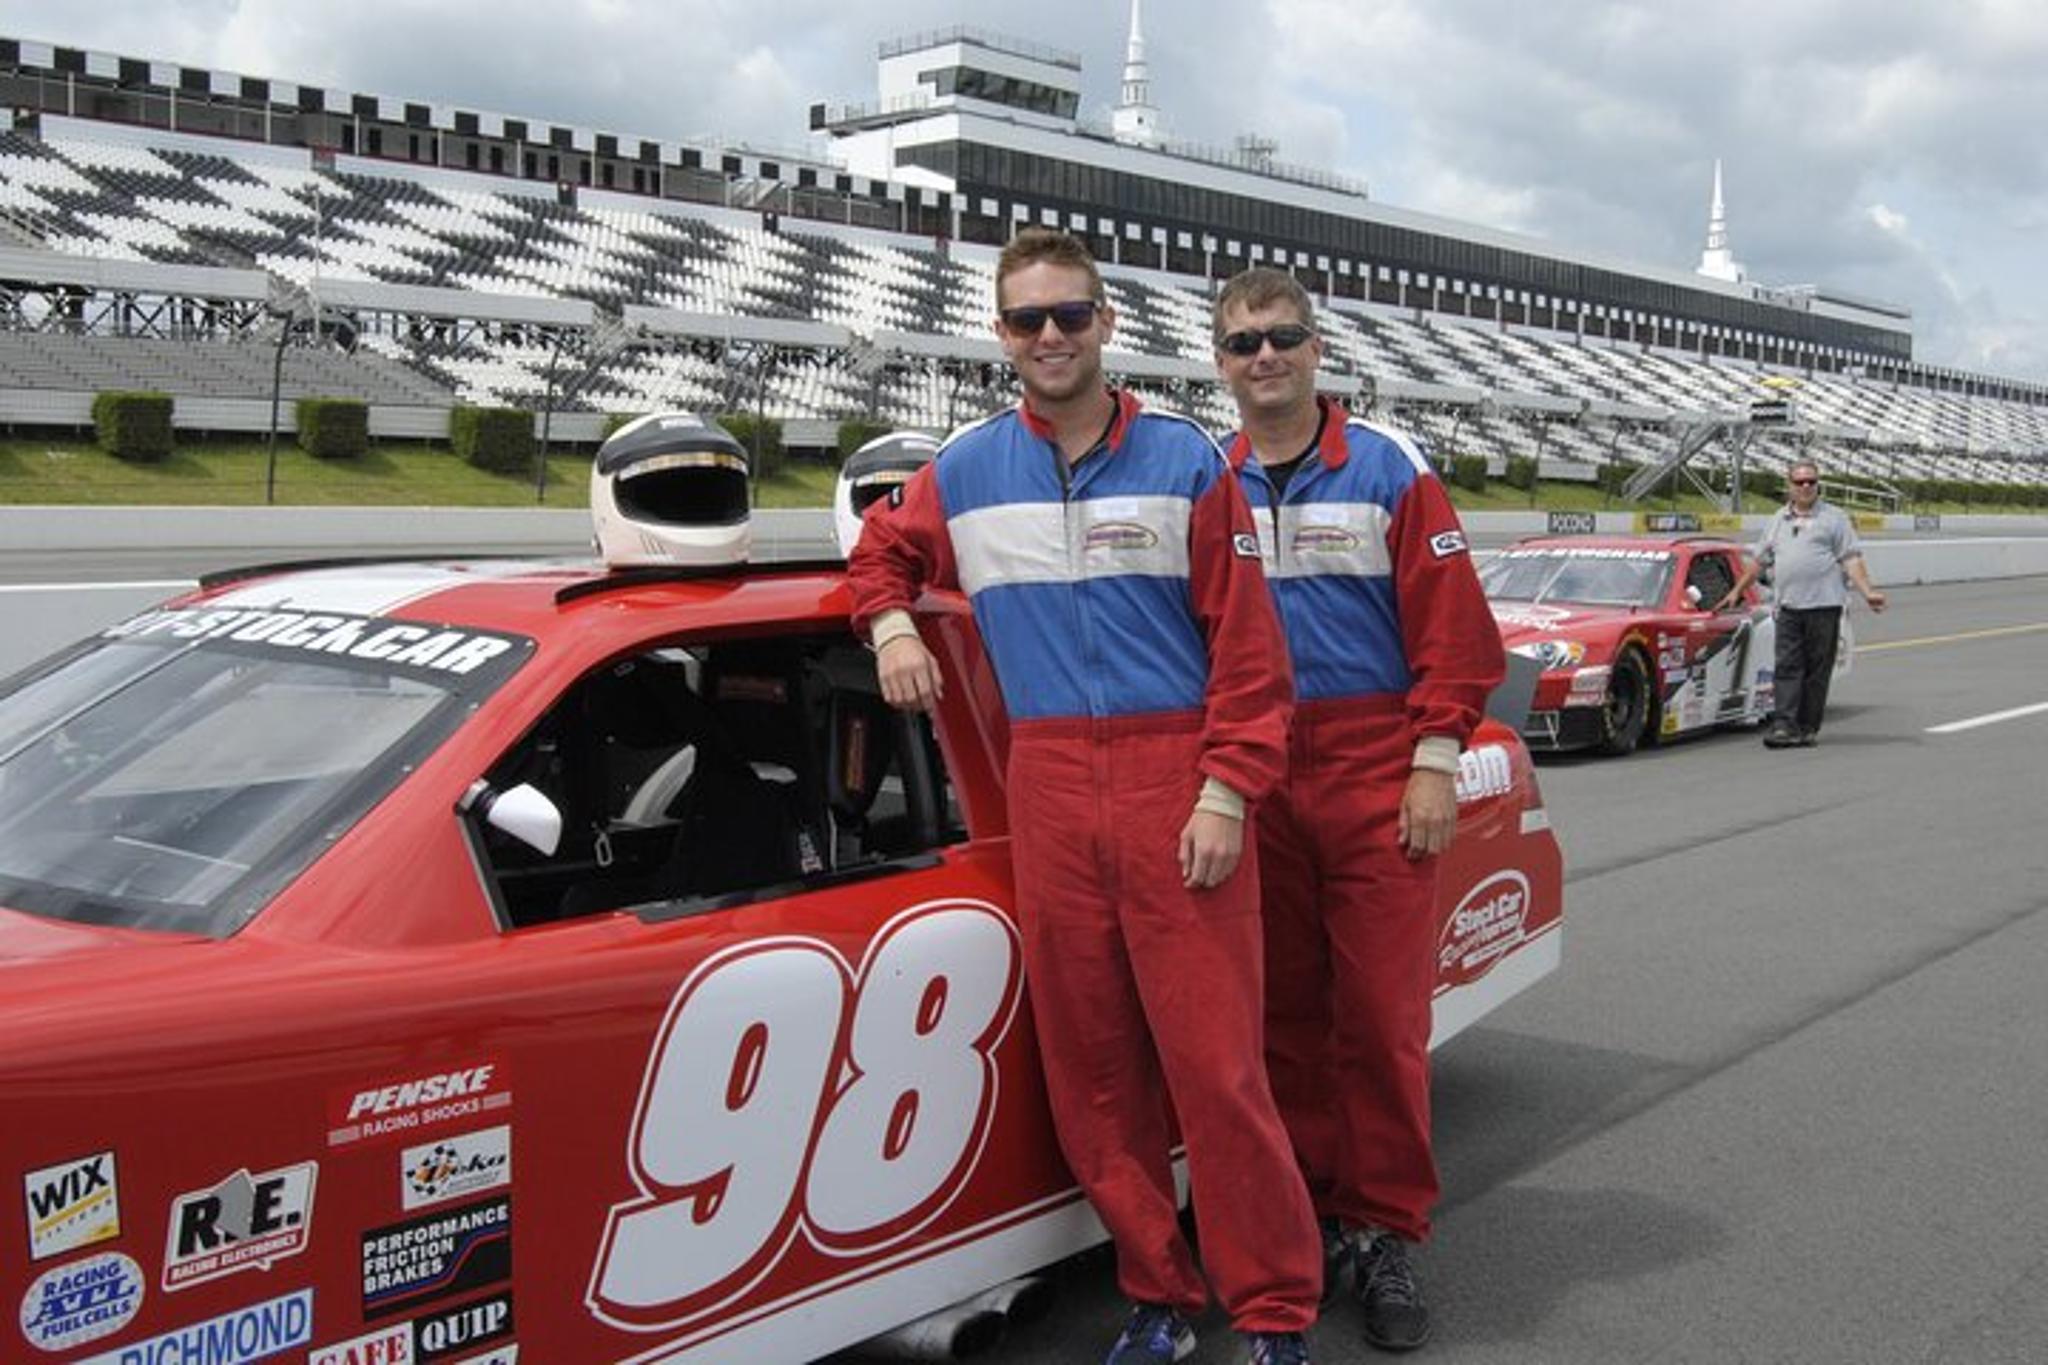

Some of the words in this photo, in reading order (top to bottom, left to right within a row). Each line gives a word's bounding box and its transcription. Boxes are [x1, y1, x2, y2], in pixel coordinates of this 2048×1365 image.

[1456, 745, 1511, 802] om
[346, 1064, 494, 1121] PENSKE
[363, 1111, 419, 1137] RACING
[422, 1098, 480, 1123] SHOCKS
[586, 898, 1026, 1333] 98
[31, 1157, 108, 1219] WIX
[171, 1256, 219, 1281] RACING
[221, 1232, 298, 1267] ELECTRONICS
[363, 1205, 508, 1257] PERFORMANCE
[363, 1237, 454, 1275] FRICTION
[43, 1261, 121, 1297] RACING
[363, 1257, 444, 1295] BRAKES
[26, 1275, 138, 1329] ATL
[421, 1301, 508, 1351] QUIP
